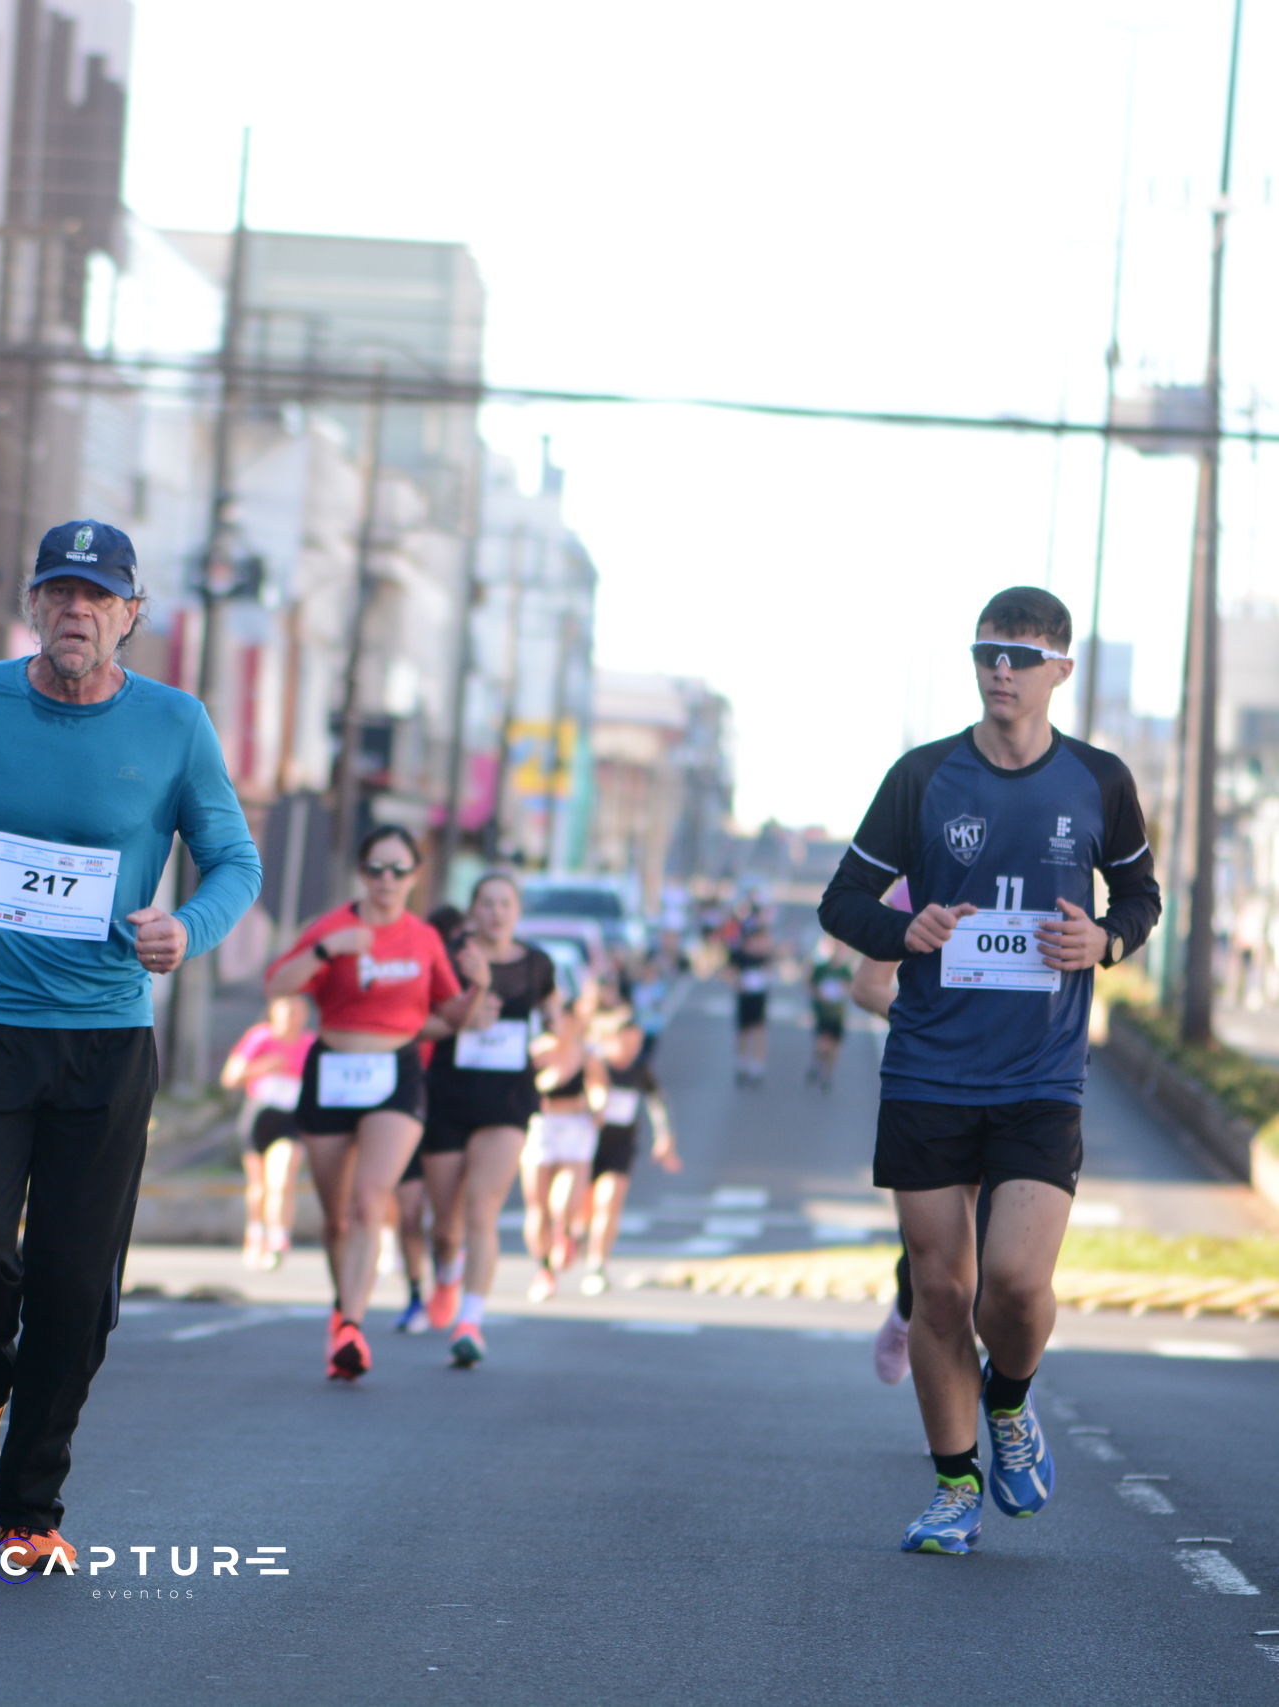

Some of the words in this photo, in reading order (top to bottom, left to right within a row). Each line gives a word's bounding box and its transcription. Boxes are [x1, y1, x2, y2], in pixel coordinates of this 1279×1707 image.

[949, 825, 982, 848] MKT
[21, 870, 78, 897] 217
[996, 876, 1024, 911] 11
[976, 933, 1027, 955] 008
